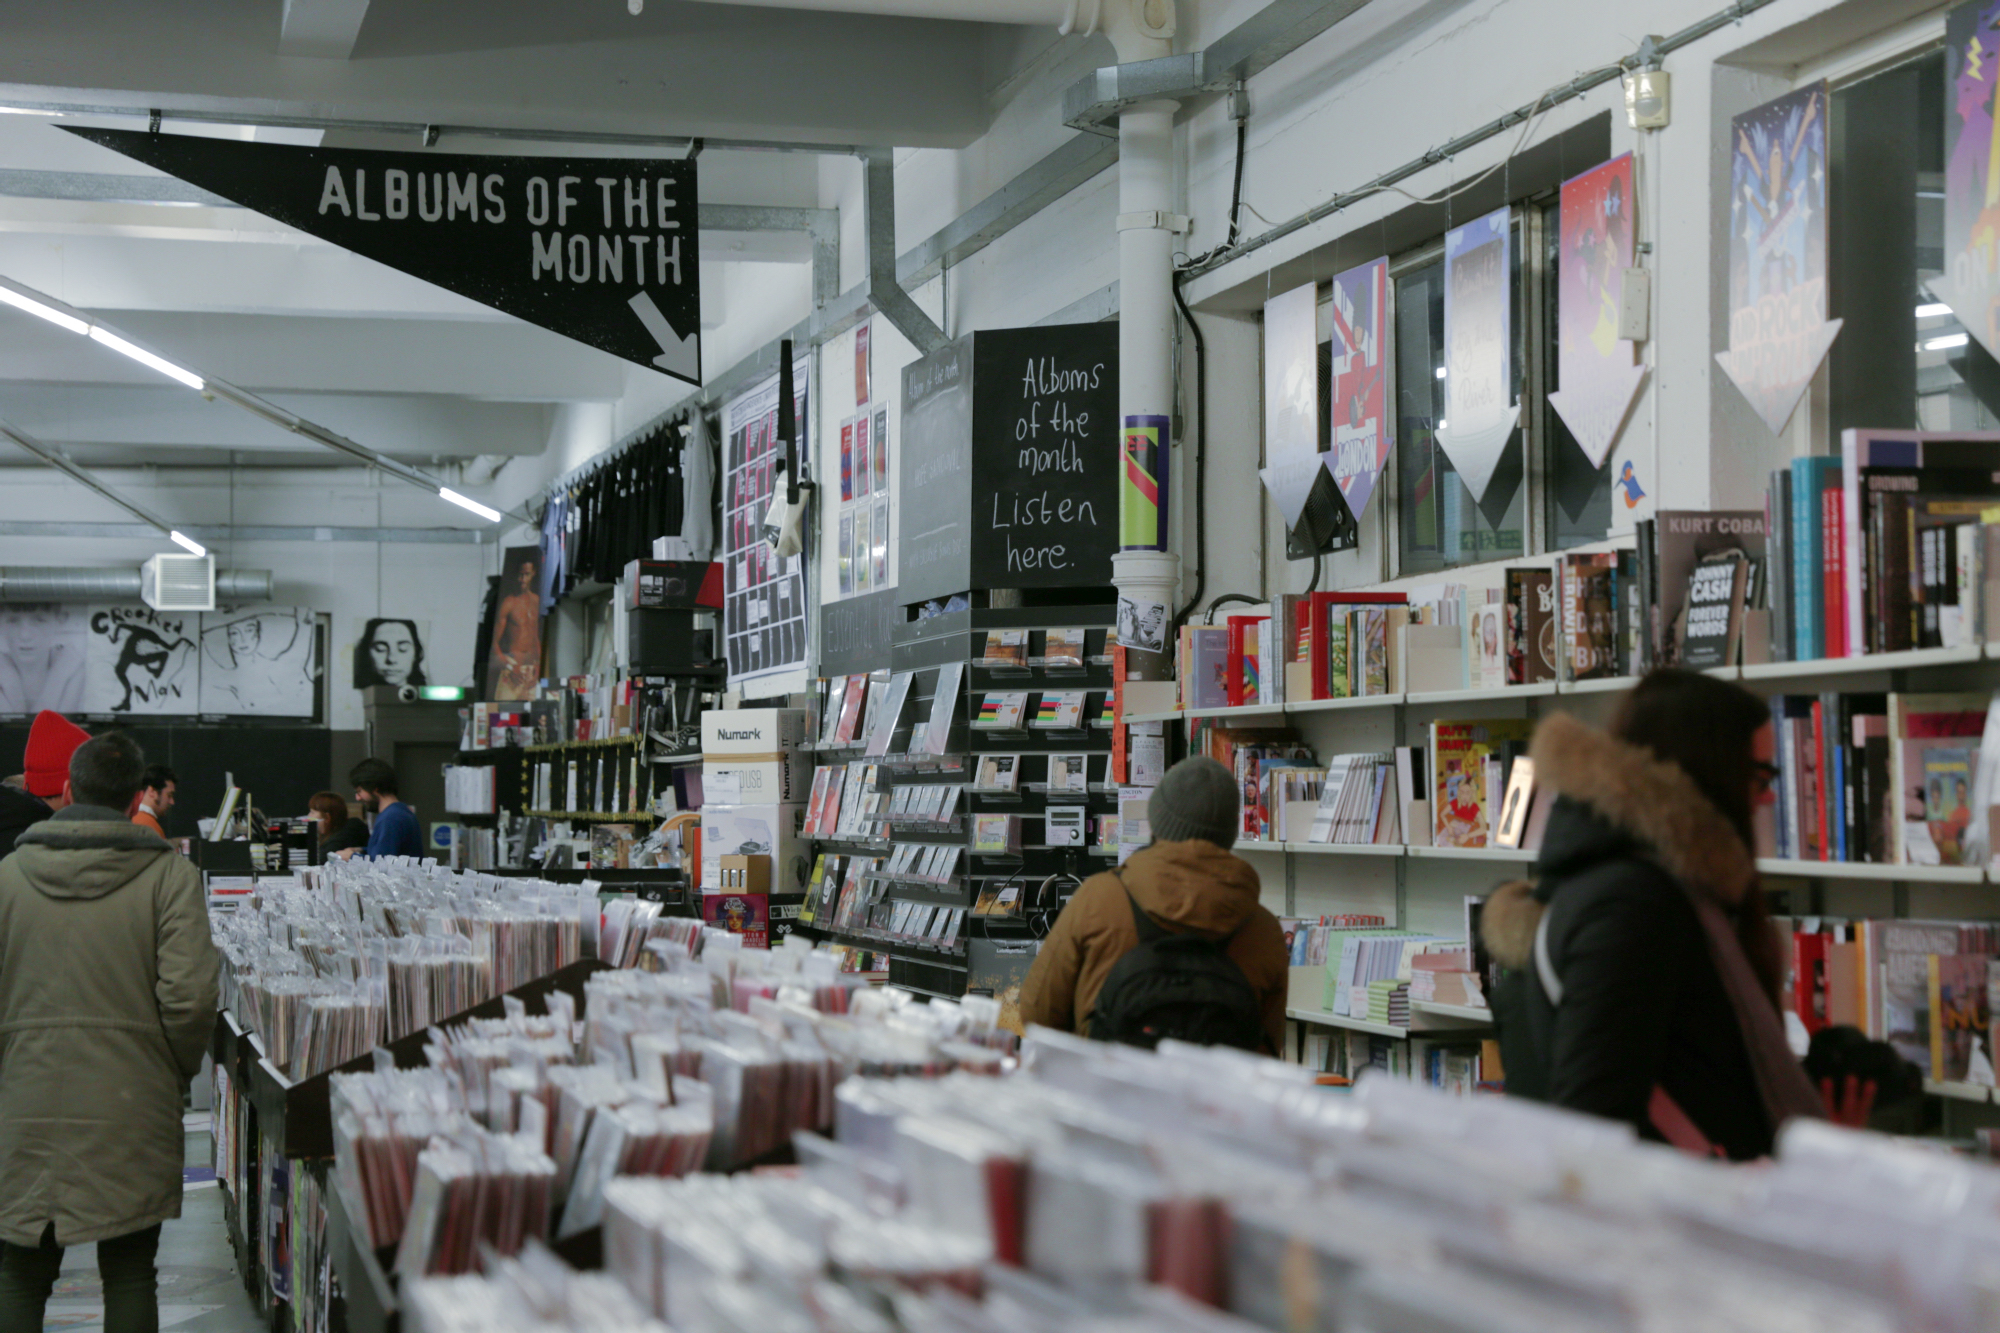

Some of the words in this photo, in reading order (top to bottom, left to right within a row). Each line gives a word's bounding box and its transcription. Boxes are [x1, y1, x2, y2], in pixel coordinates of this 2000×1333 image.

[318, 165, 507, 224] ALBUMS
[526, 175, 582, 227] OF
[595, 176, 681, 228] THE
[532, 231, 682, 286] MONTH
[1016, 401, 1041, 441] of
[1049, 400, 1089, 438] the
[1019, 438, 1084, 476] month
[1338, 434, 1377, 480] LONDON
[992, 490, 1097, 529] Listen
[1669, 518, 1714, 534] KURT
[1007, 533, 1075, 573] here.
[1691, 579, 1733, 603] CASH
[1687, 620, 1728, 638] WORDS
[1689, 604, 1729, 623] FOREVER
[717, 728, 762, 741] Numark
